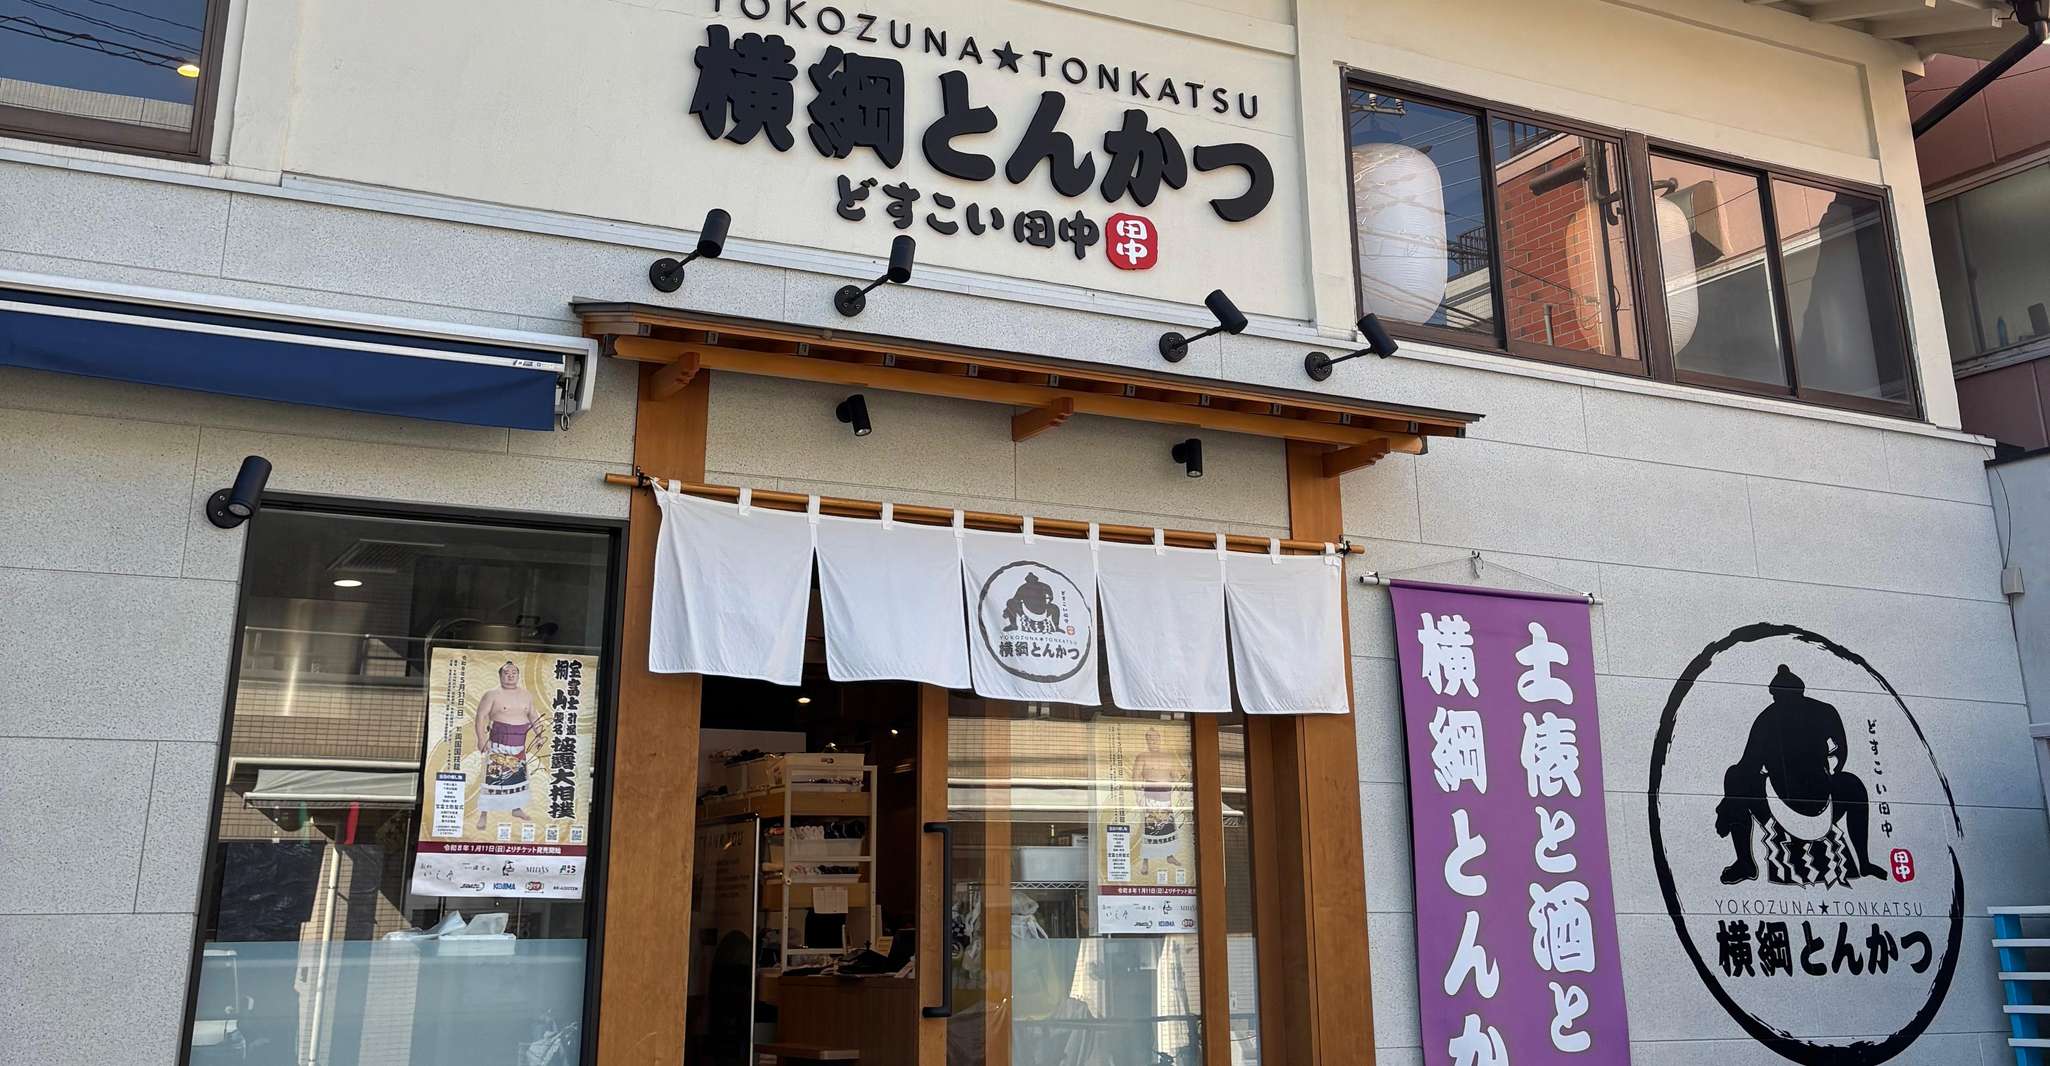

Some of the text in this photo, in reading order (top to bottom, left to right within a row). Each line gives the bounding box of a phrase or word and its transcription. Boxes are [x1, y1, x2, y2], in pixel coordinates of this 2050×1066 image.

[1033, 50, 1258, 119] TONKATSU
[690, 25, 1274, 222] 横綱とんかつ
[836, 174, 1100, 260] どすこい田中
[1115, 218, 1151, 267] 田中
[999, 641, 1080, 660] 横綱とんかつ
[1867, 719, 1893, 839] どすこい田中
[1417, 612, 1510, 1066] 横綱とんか
[1515, 622, 1595, 1052] 土俵と酒と
[1893, 850, 1912, 881] 田中
[1715, 899, 1923, 917] YOKOZUNA TONKATSU
[1716, 919, 1933, 978] 横綱とんかつ
